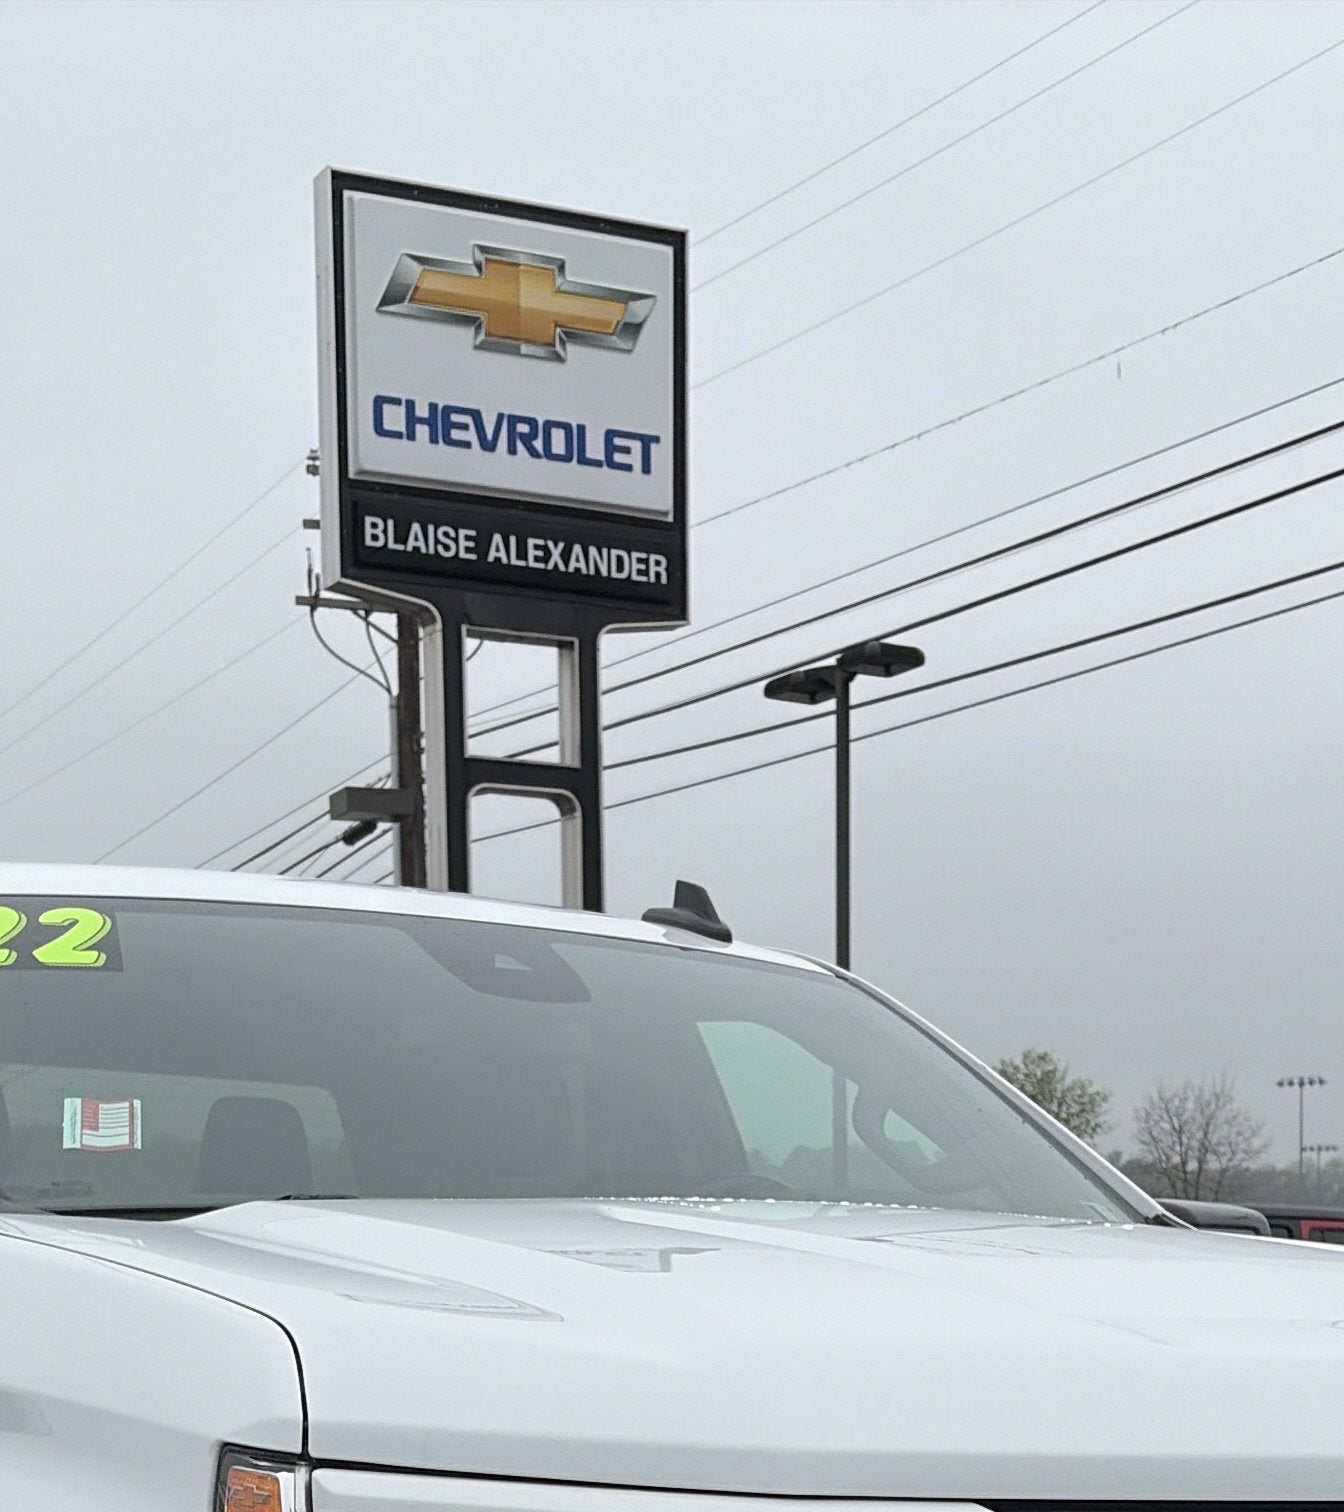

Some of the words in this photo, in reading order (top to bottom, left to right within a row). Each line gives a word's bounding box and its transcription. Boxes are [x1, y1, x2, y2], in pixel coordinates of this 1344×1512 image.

[372, 394, 661, 475] CHEVROLET
[363, 515, 477, 561] BLAISE
[487, 532, 669, 585] ALEXANDER
